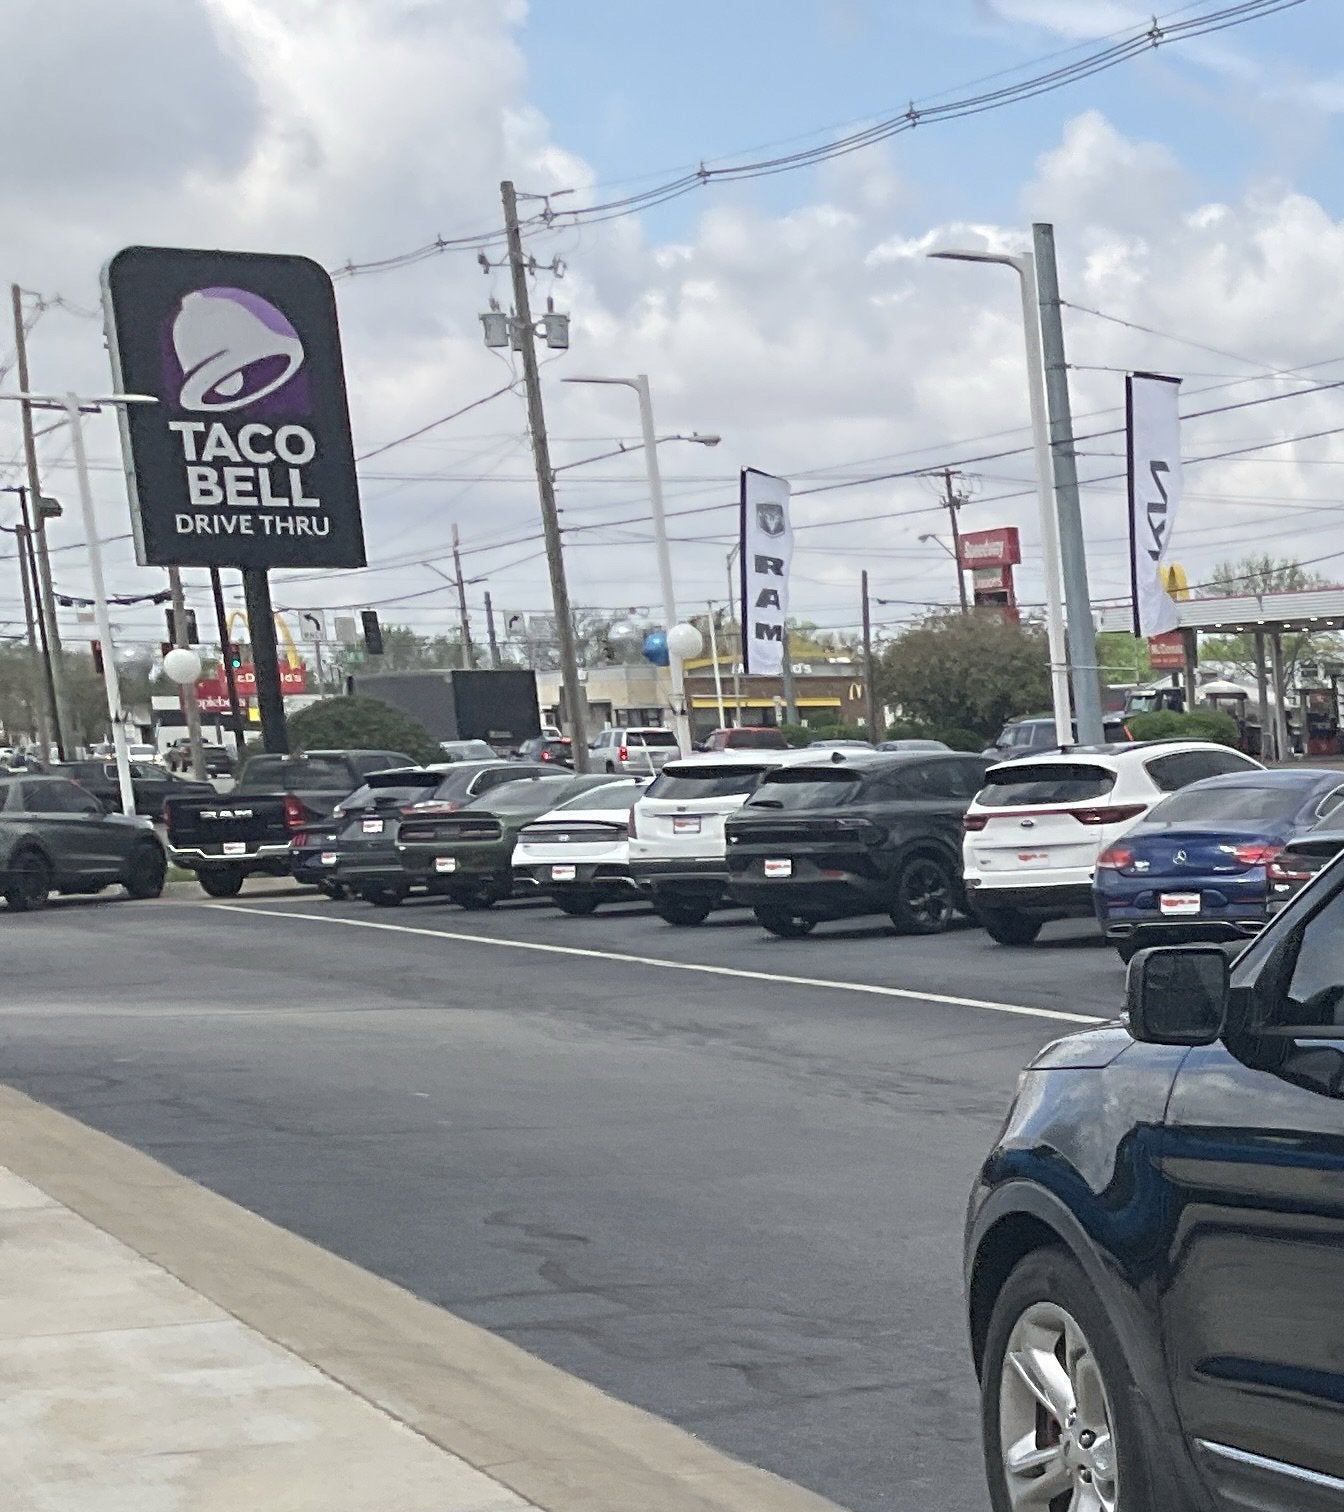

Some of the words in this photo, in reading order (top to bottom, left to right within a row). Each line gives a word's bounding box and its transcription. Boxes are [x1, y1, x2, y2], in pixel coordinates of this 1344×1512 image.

[168, 421, 316, 464] TACO
[186, 465, 321, 508] BELL
[175, 514, 254, 534] DRIVE
[258, 516, 329, 536] THRU
[755, 554, 783, 642] RAM
